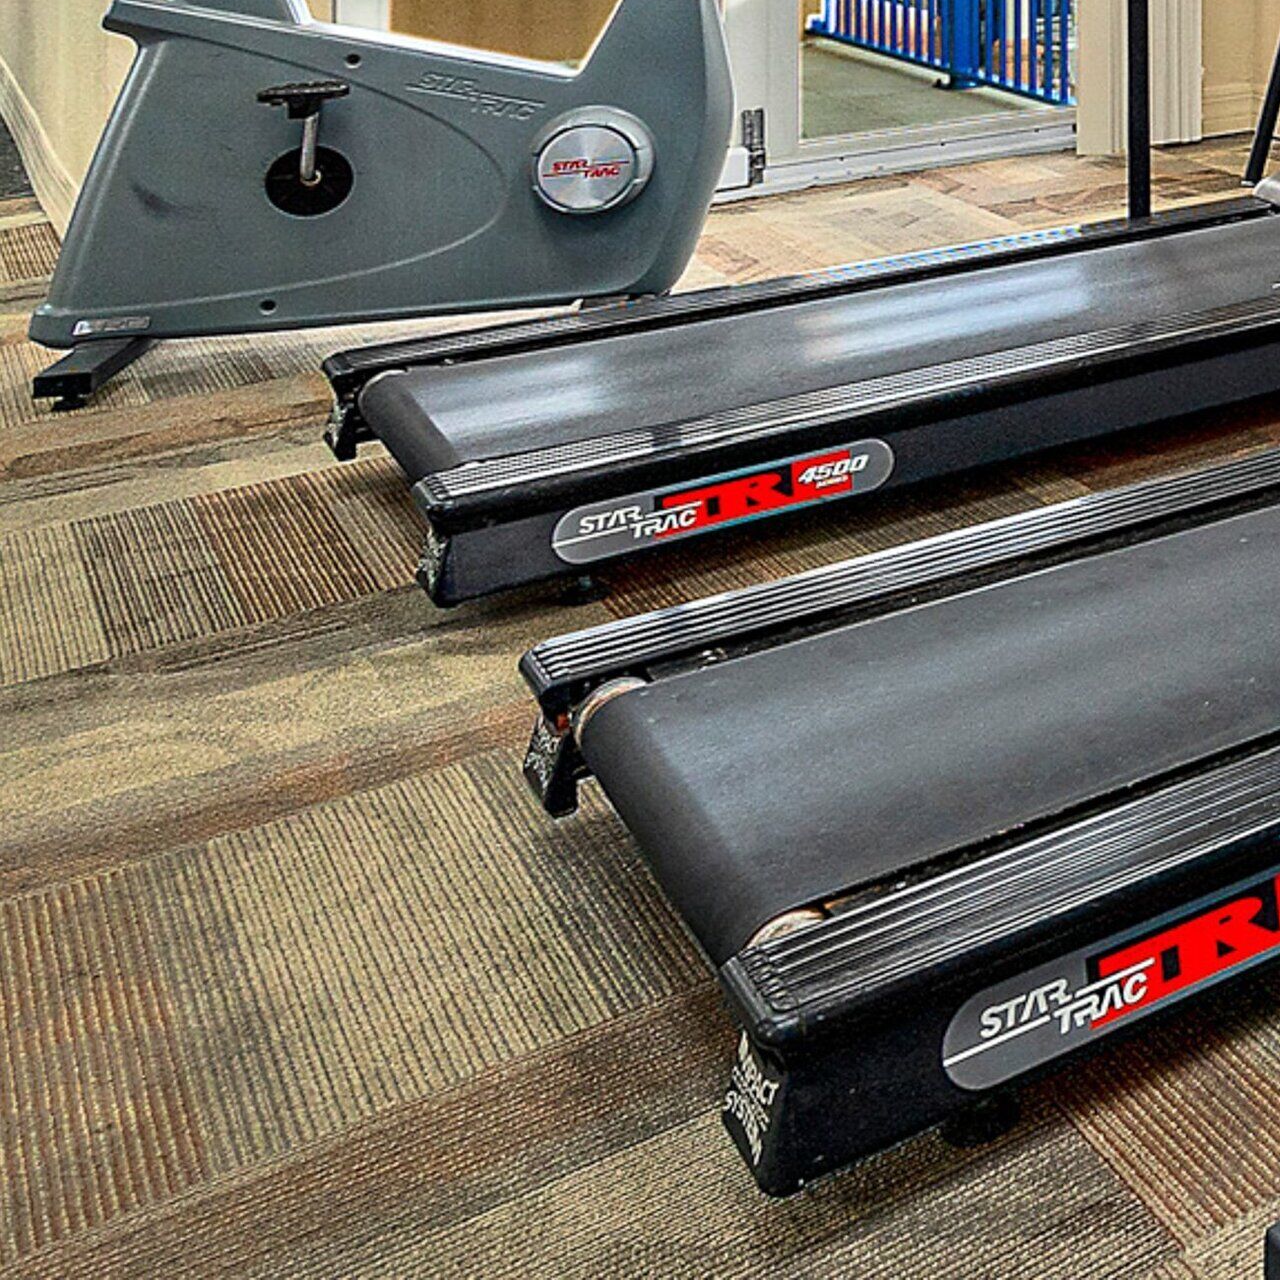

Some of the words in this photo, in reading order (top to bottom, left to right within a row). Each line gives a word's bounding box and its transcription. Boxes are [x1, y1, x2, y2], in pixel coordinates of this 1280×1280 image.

[553, 158, 588, 172] STAR
[798, 454, 869, 484] 4500
[578, 505, 645, 534] STAR
[631, 509, 697, 539] TRAC
[980, 977, 1072, 1039] STAR
[1054, 972, 1148, 1035] TRAC
